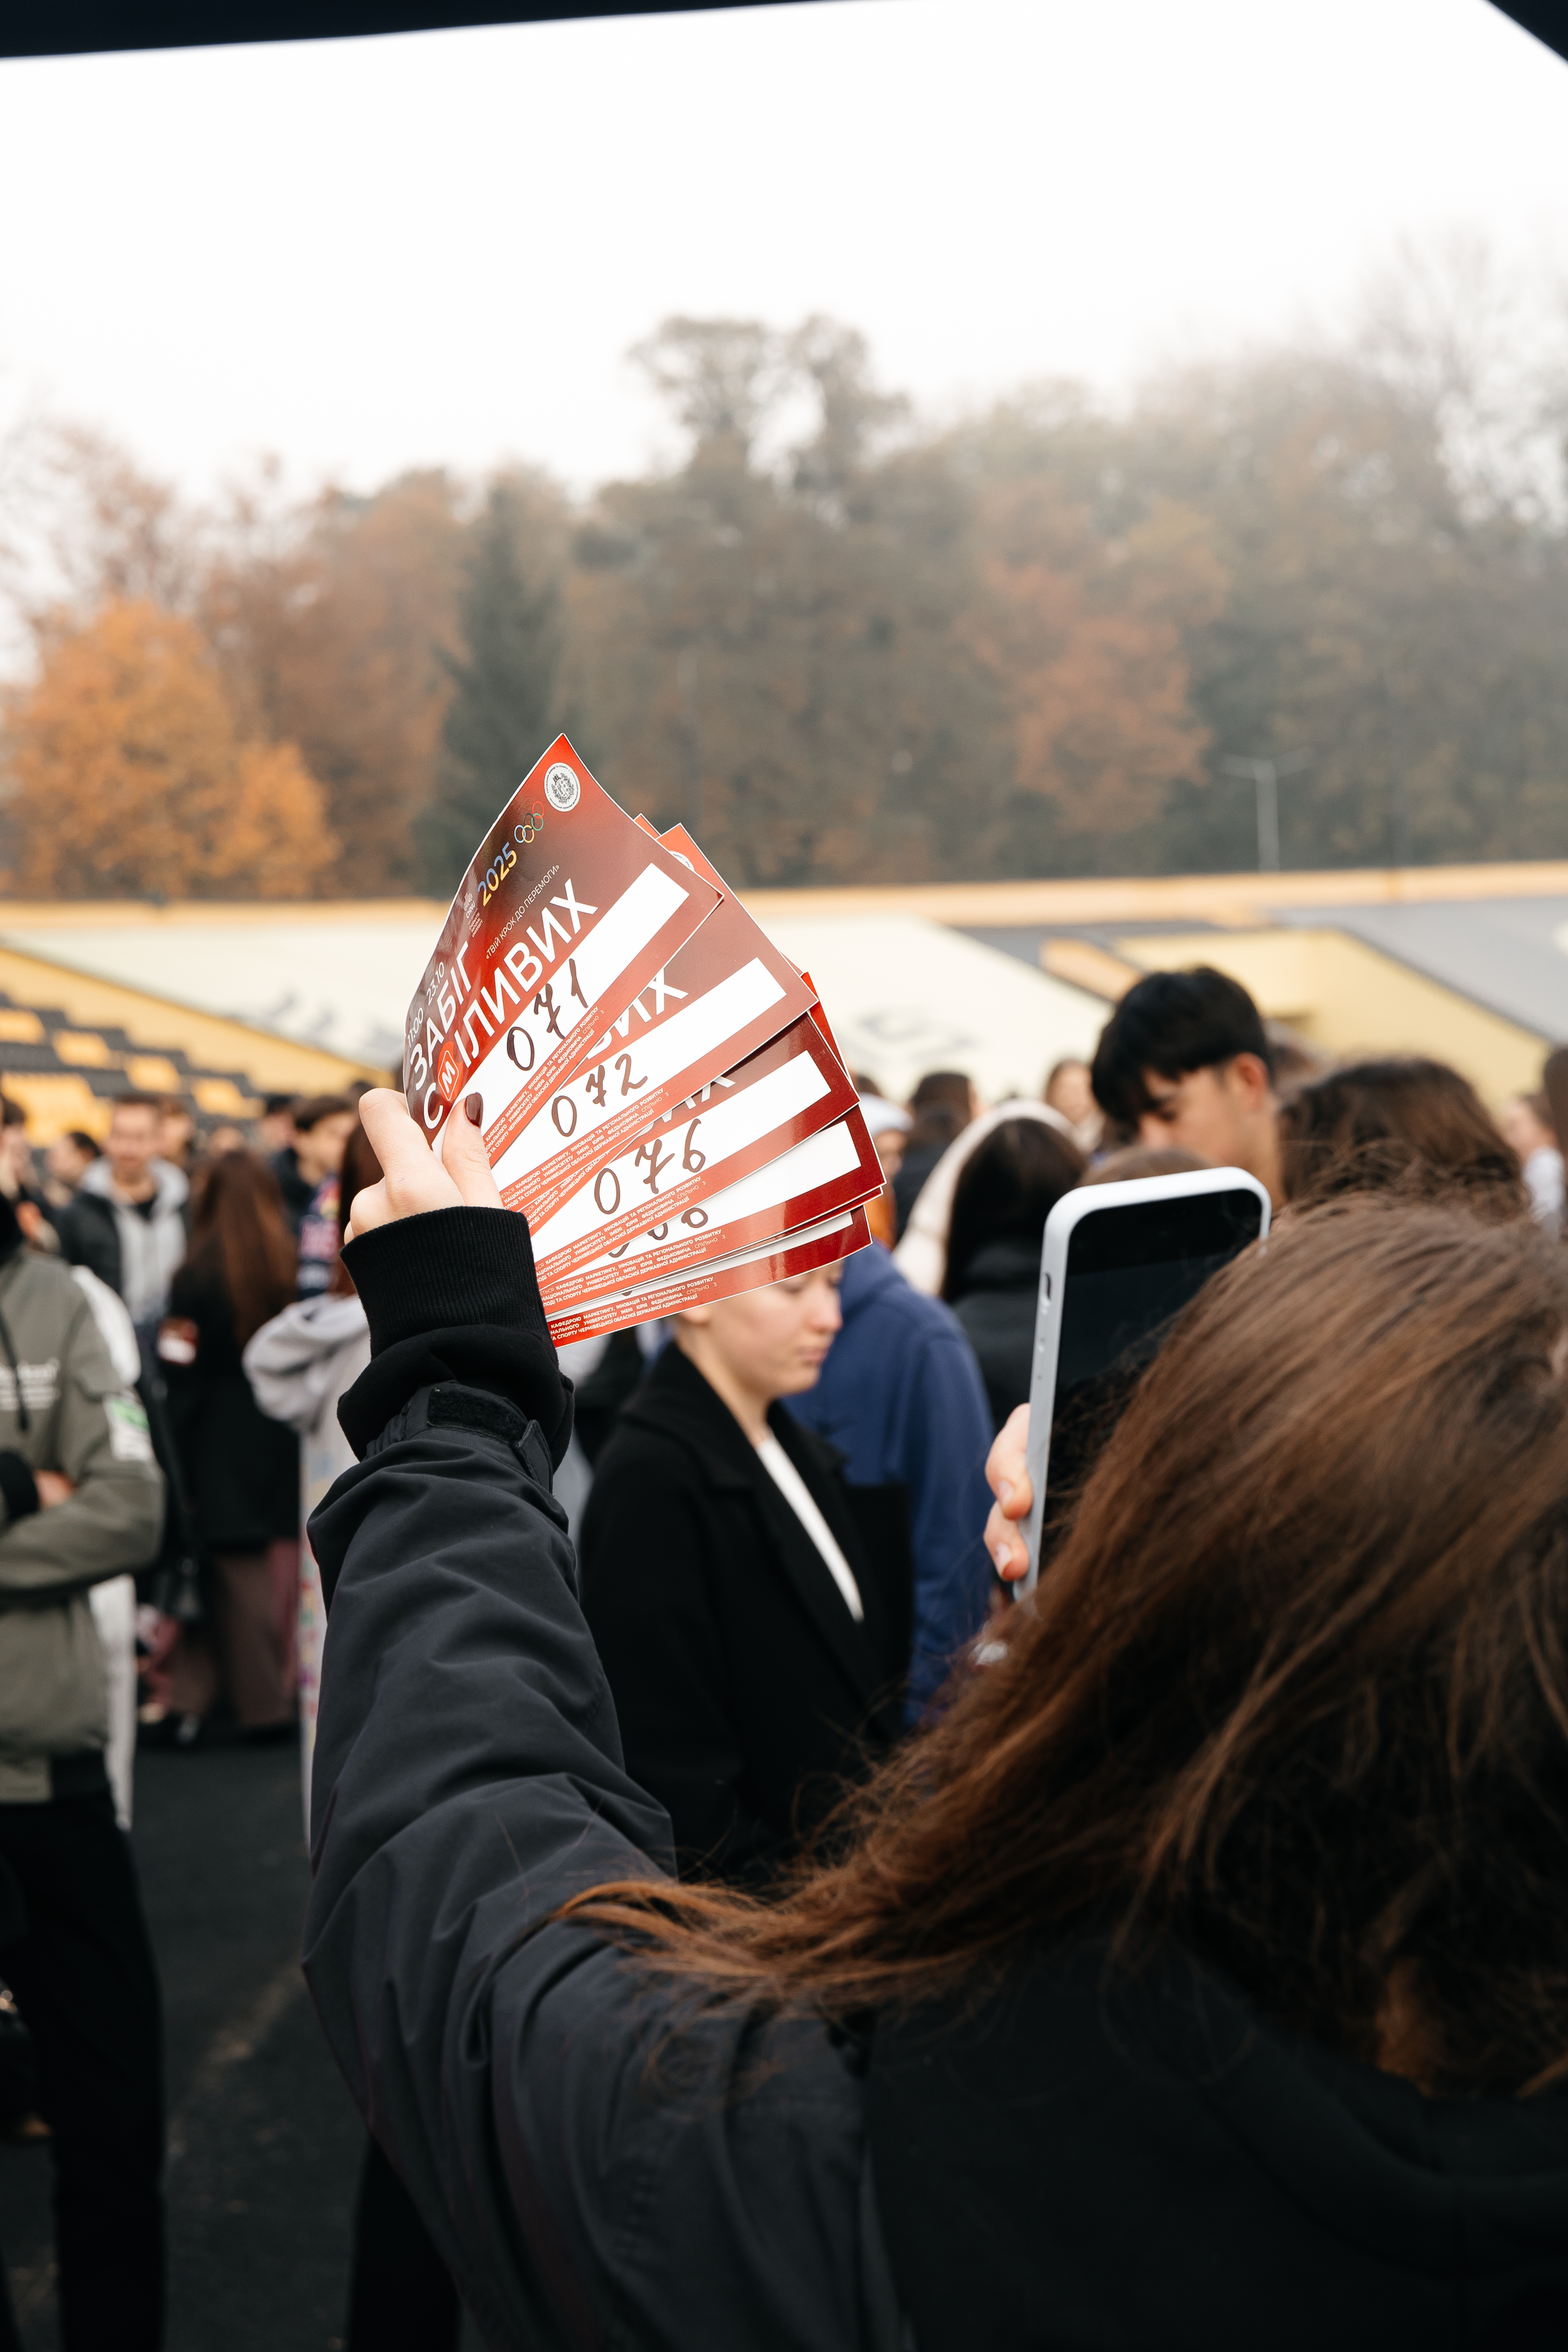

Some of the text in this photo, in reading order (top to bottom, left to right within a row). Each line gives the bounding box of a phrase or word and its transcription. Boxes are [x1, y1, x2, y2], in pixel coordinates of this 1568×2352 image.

[466, 901, 475, 918] CHNU
[477, 842, 517, 907] 2025
[486, 864, 559, 960] «ТВІЙ КРОК ДО ПЕРЕМОГИ»
[471, 916, 481, 933] NATIONAL
[472, 919, 483, 938] UNIVERSITY
[407, 962, 445, 1048] 11:00 23.10
[410, 940, 472, 1091] ЗАБІГ
[506, 958, 588, 1071] 071
[485, 1118, 505, 1142] КАФЕДРОЮ
[505, 1090, 529, 1118] МАРКЕТИНГУ,
[528, 1066, 548, 1089] ІННОВАЦІЙ
[552, 1028, 580, 1061] РЕГІОНАЛЬНОГО
[579, 1006, 598, 1028] РОЗВИТКУ
[495, 1131, 508, 1147] СПОРТУ
[508, 1102, 532, 1131] ЧЕРНІВЕЦЬКОЇ
[532, 1082, 550, 1103] ОБЛАСНОЇ
[548, 1058, 570, 1084] ДЕРЖАВНОЇ
[569, 1029, 594, 1060] АДМІНІСТРАЦІЇ
[508, 1093, 532, 1122] УНІВЕРСИТЕТУ
[534, 1079, 545, 1091] ІМЕНІ
[546, 1065, 556, 1077] ЮРІЯ
[558, 1036, 582, 1063] ФЕДЬКОВИЧА
[583, 1016, 599, 1034] СПІЛЬНО
[552, 1053, 648, 1137] 072
[504, 1178, 541, 1203] НАЦІОНАЛЬНОГО
[543, 1155, 573, 1177] УНІВЕРСИТЕТУ
[576, 1145, 589, 1155] ІМЕНІ
[592, 1135, 604, 1145] ЮРІЯ
[607, 1113, 639, 1134] ФЕДЬКОВИЧА
[641, 1097, 662, 1112] СПІЛЬНО
[515, 1171, 540, 1189] КАФЕДРОЮ
[541, 1151, 570, 1172] МАРКЕТИНГУ,
[570, 1133, 595, 1152] ІННОВАЦІЙ
[602, 1105, 639, 1131] РЕГІОНАЛЬНОГО
[639, 1088, 663, 1106] РОЗВИТКУ
[524, 1183, 541, 1197] СПОРТУ
[541, 1163, 571, 1185] ЧЕРНІВЕЦЬКОЇ
[571, 1148, 593, 1166] ОБЛАСНОЇ
[593, 1131, 620, 1152] ДЕРЖАВНОЇ
[621, 1108, 654, 1134] АДМІНІСТРАЦІЇ
[594, 1118, 706, 1215] 076
[536, 1255, 571, 1277] АЦІОНАЛЬНОГО
[574, 1235, 605, 1255] УНІВЕРСИТЕТУ
[609, 1227, 622, 1236] ІМЕНІ
[626, 1218, 638, 1227] ЮРІЯ
[641, 1199, 674, 1218] ФЕДЬКОВИЧА
[677, 1185, 699, 1199] СПІЛЬНО
[544, 1196, 559, 1212] СПОРТУ
[559, 1171, 586, 1198] ЧЕРНІВЕЦЬКОЇ
[545, 1248, 572, 1265] КАФЕДРОЮ
[573, 1231, 603, 1249] МАРКЕТИНГУ,
[604, 1216, 629, 1232] ІННОВАЦІЙ
[637, 1191, 675, 1214] РЕГІОНАЛЬНОГО
[676, 1176, 700, 1192] РОЗВИТКУ
[541, 1284, 583, 1301] НАЦІОНАЛЬНОГО
[586, 1271, 619, 1286] УНІВЕРСИТЕТУ
[657, 1247, 691, 1261] ФЕДЬКОВИЧА
[695, 1238, 717, 1248] СПІЛЬНО
[554, 1261, 570, 1273] СПОРТУ
[571, 1243, 603, 1263] ЧЕРНІВЕЦЬКОЇ
[603, 1230, 626, 1246] ОБЛАСНОЇ
[626, 1215, 654, 1234] ДЕРЖАВНОЇ
[655, 1196, 689, 1218] АДМІНІСТРАЦІЇ
[556, 1278, 584, 1290] КАФЕДРОЮ
[585, 1267, 617, 1280] МАРКЕТИНГУ,
[618, 1256, 644, 1269] ІННОВАЦІЙ
[653, 1240, 693, 1256] РЕГІОНАЛЬНОГО
[695, 1229, 721, 1242] РОЗВИТКУ
[563, 1290, 581, 1300] СПОРТУ
[582, 1278, 615, 1293] ЧЕРНІВЕЦЬКОЇ
[615, 1270, 639, 1282] ОБЛАСНОЇ
[640, 1260, 668, 1274] ДЕРЖАВНОЇ
[670, 1247, 706, 1264] АДМІНІСТРАЦІЇ
[551, 1317, 581, 1328] КАФЕДРОЮ
[583, 1307, 615, 1319] МАРКЕТИНГУ,
[616, 1298, 640, 1309] ІННОВАЦІЙ
[648, 1285, 685, 1299] РЕГІОНАЛЬНОГО
[687, 1277, 713, 1288] РОЗВИТКУ
[557, 1330, 577, 1339] СПОРТУ
[578, 1318, 613, 1332] ЧЕРНІВЕЦЬКОЇ
[613, 1312, 636, 1322] ОБЛАСНОЇ
[636, 1304, 662, 1316] ДЕРЖАВНОЇ
[662, 1293, 697, 1308] АДМІНІСТРАЦІЇ
[584, 1312, 617, 1325] УНІВЕРСИТЕТУ
[651, 1293, 683, 1305] ФЕДЬКОВИЧА
[686, 1285, 709, 1294] СПІЛЬНО
